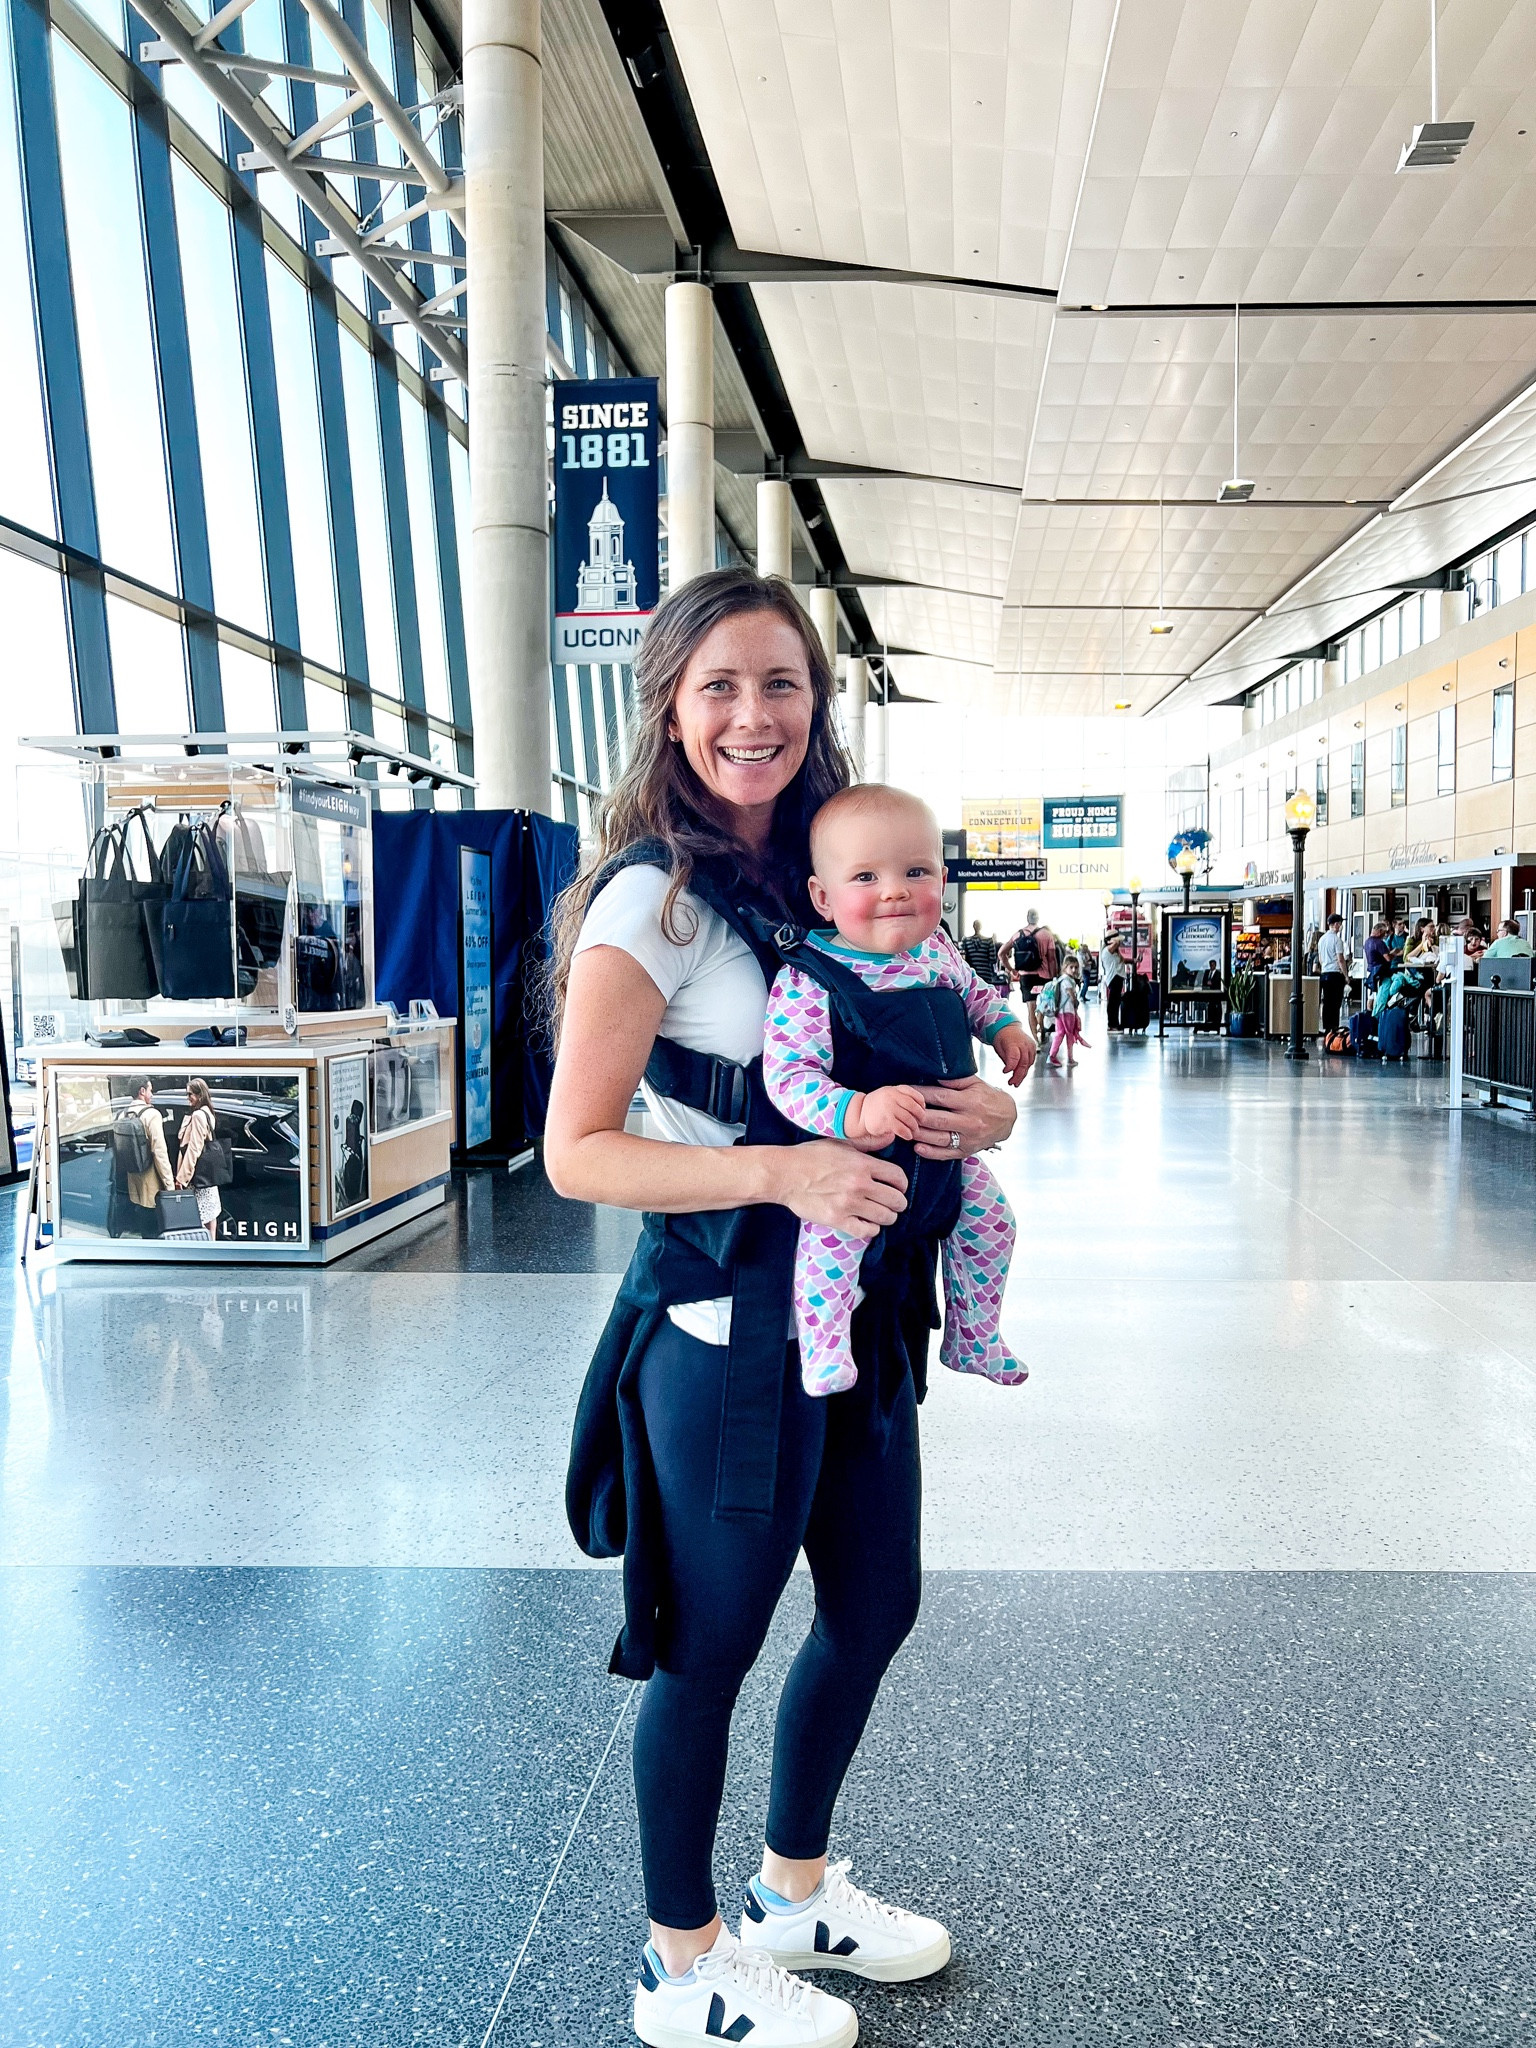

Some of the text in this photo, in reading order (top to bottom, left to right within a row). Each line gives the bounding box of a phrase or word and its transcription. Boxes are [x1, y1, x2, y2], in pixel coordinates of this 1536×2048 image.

[562, 402, 649, 430] SINCE
[561, 432, 650, 469] 1881
[1052, 806, 1117, 817] PROUD HOME
[969, 817, 1033, 826] CONNECTICUT
[1052, 823, 1117, 838] HUSKIES
[994, 859, 1024, 867] Beverage
[1059, 863, 1109, 874] UCONN
[983, 870, 1006, 878] Nursing
[1259, 869, 1279, 887] NEWS
[1280, 871, 1307, 884] HARTD
[1161, 885, 1198, 893] HARTFD
[466, 890, 486, 901] LEIGH
[1183, 924, 1210, 933] Lindsey
[464, 935, 489, 948] 40% OFF
[222, 1220, 298, 1237] LEIGH
